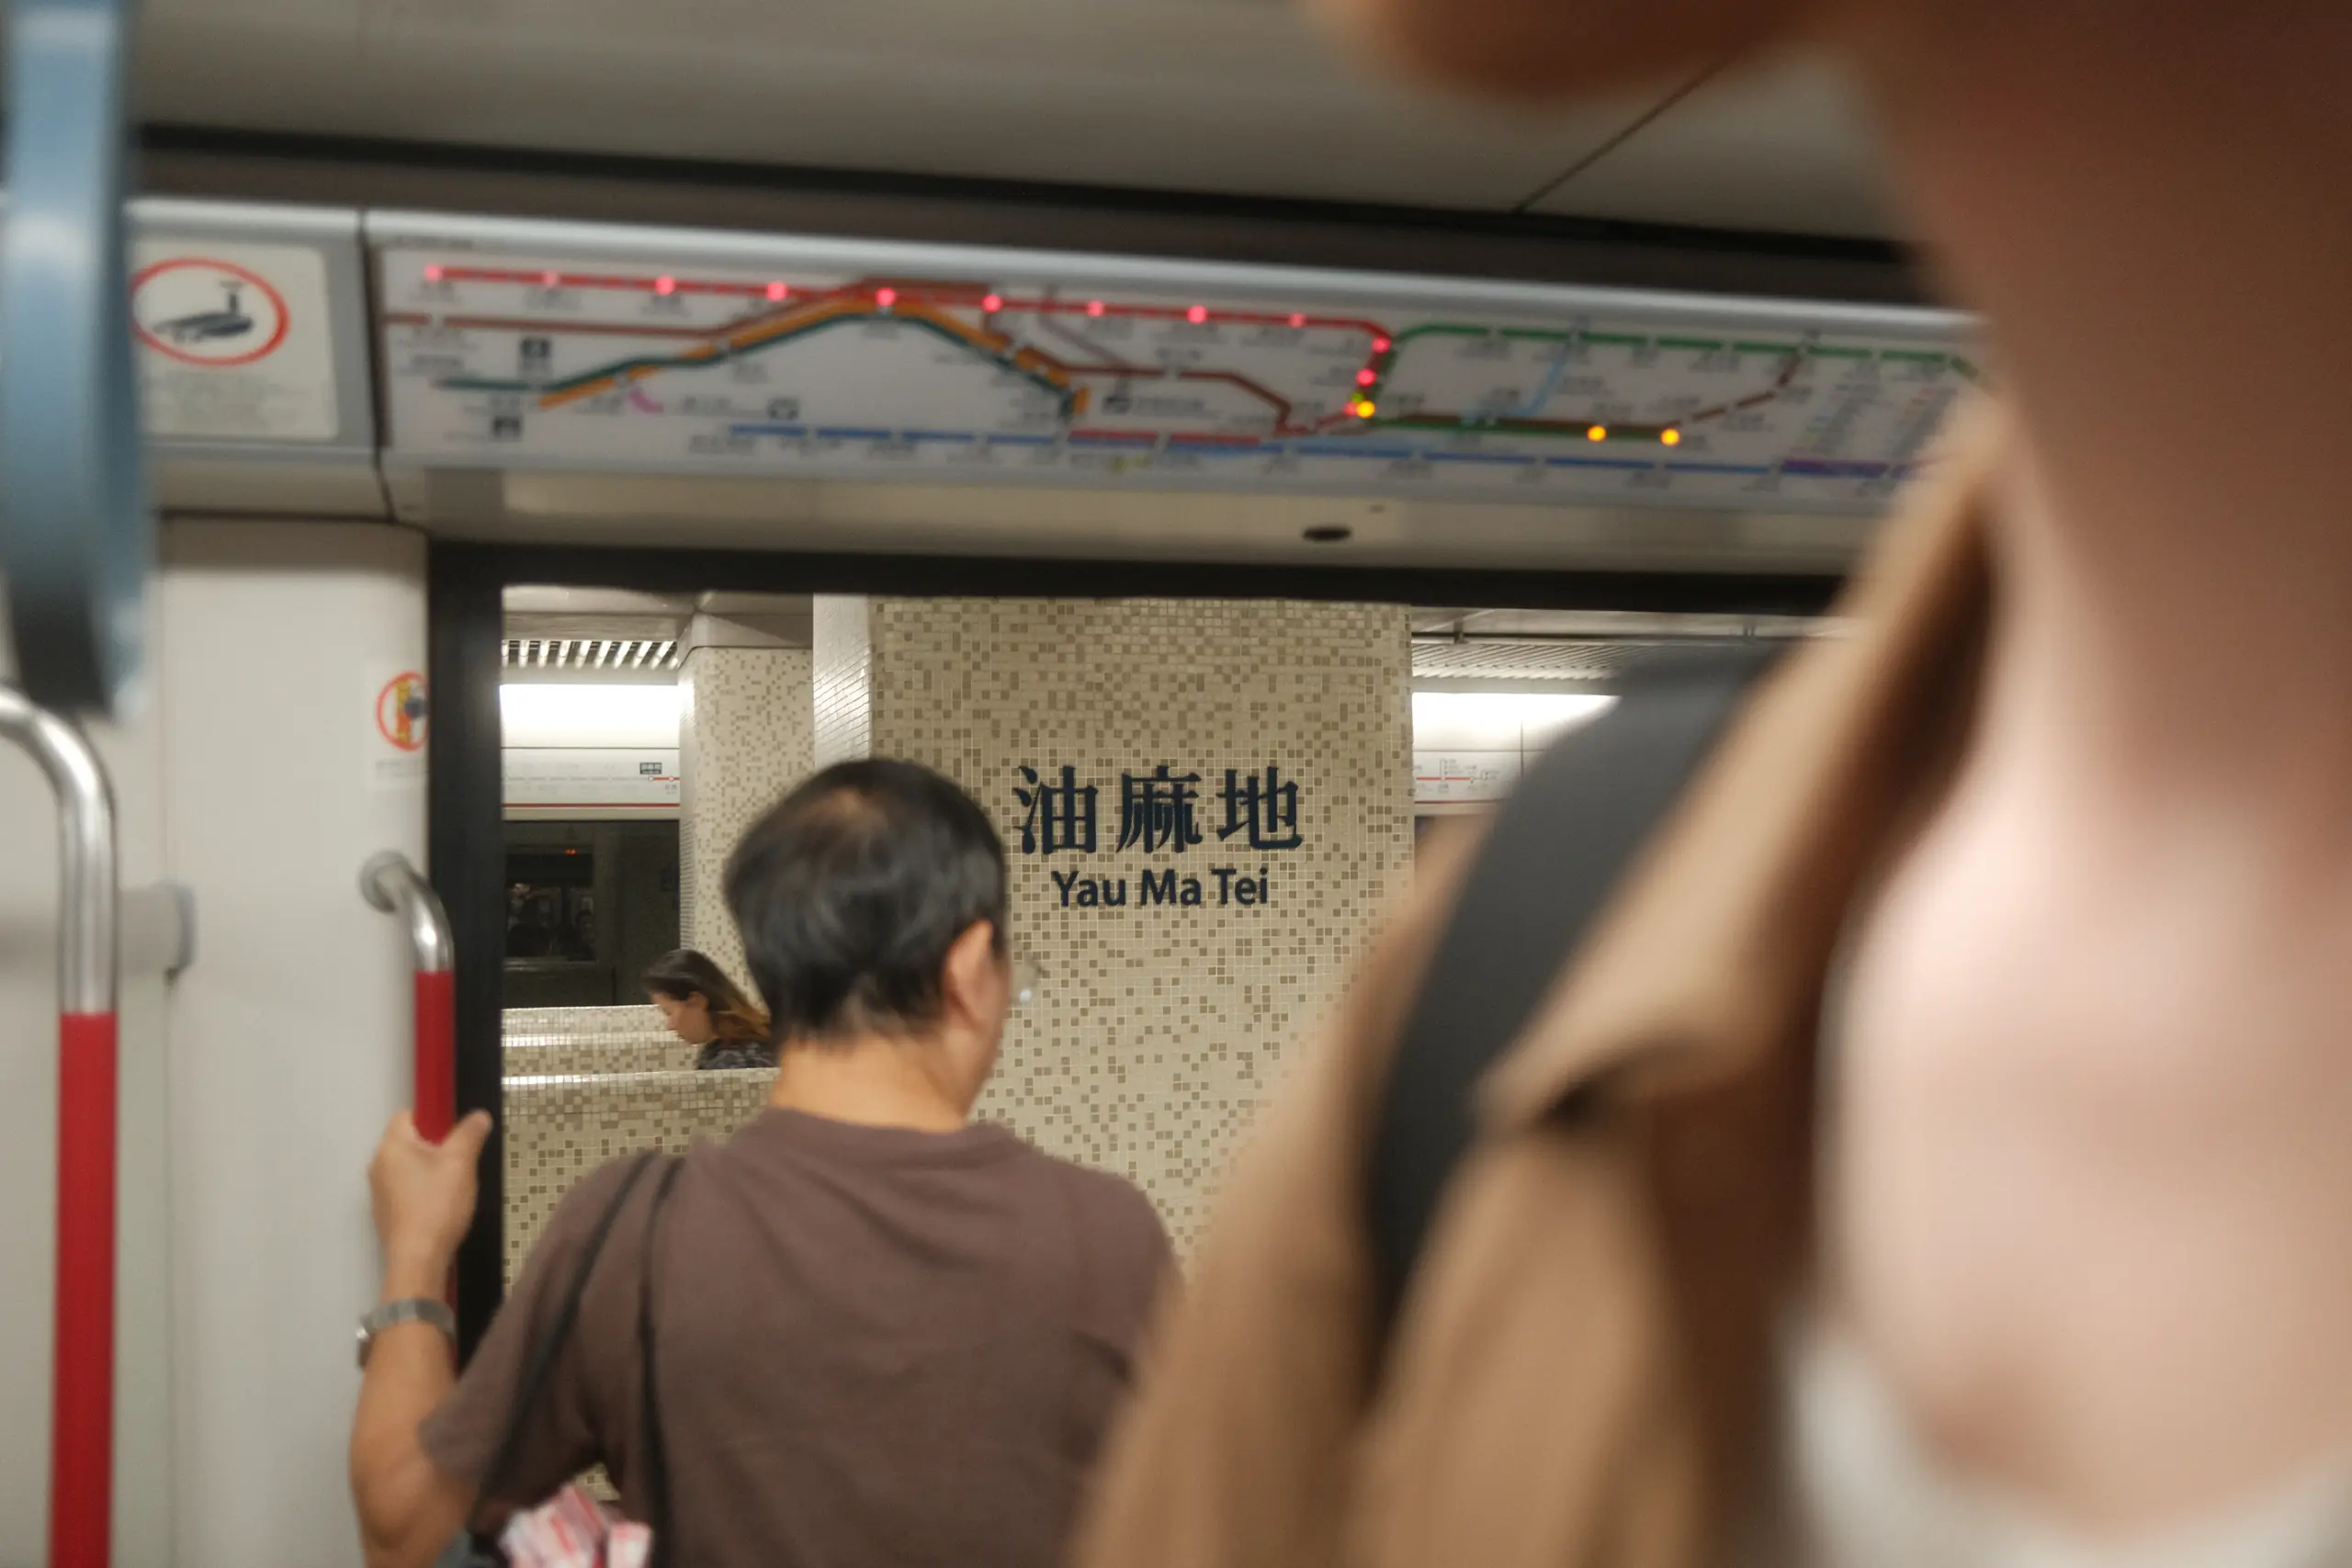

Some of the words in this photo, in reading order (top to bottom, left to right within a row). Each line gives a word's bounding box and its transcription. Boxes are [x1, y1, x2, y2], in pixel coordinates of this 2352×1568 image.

[1012, 765, 1303, 854] 油麻地
[1051, 871, 1126, 907] Yau
[1140, 869, 1202, 906] Ma
[1211, 868, 1268, 905] Tei
